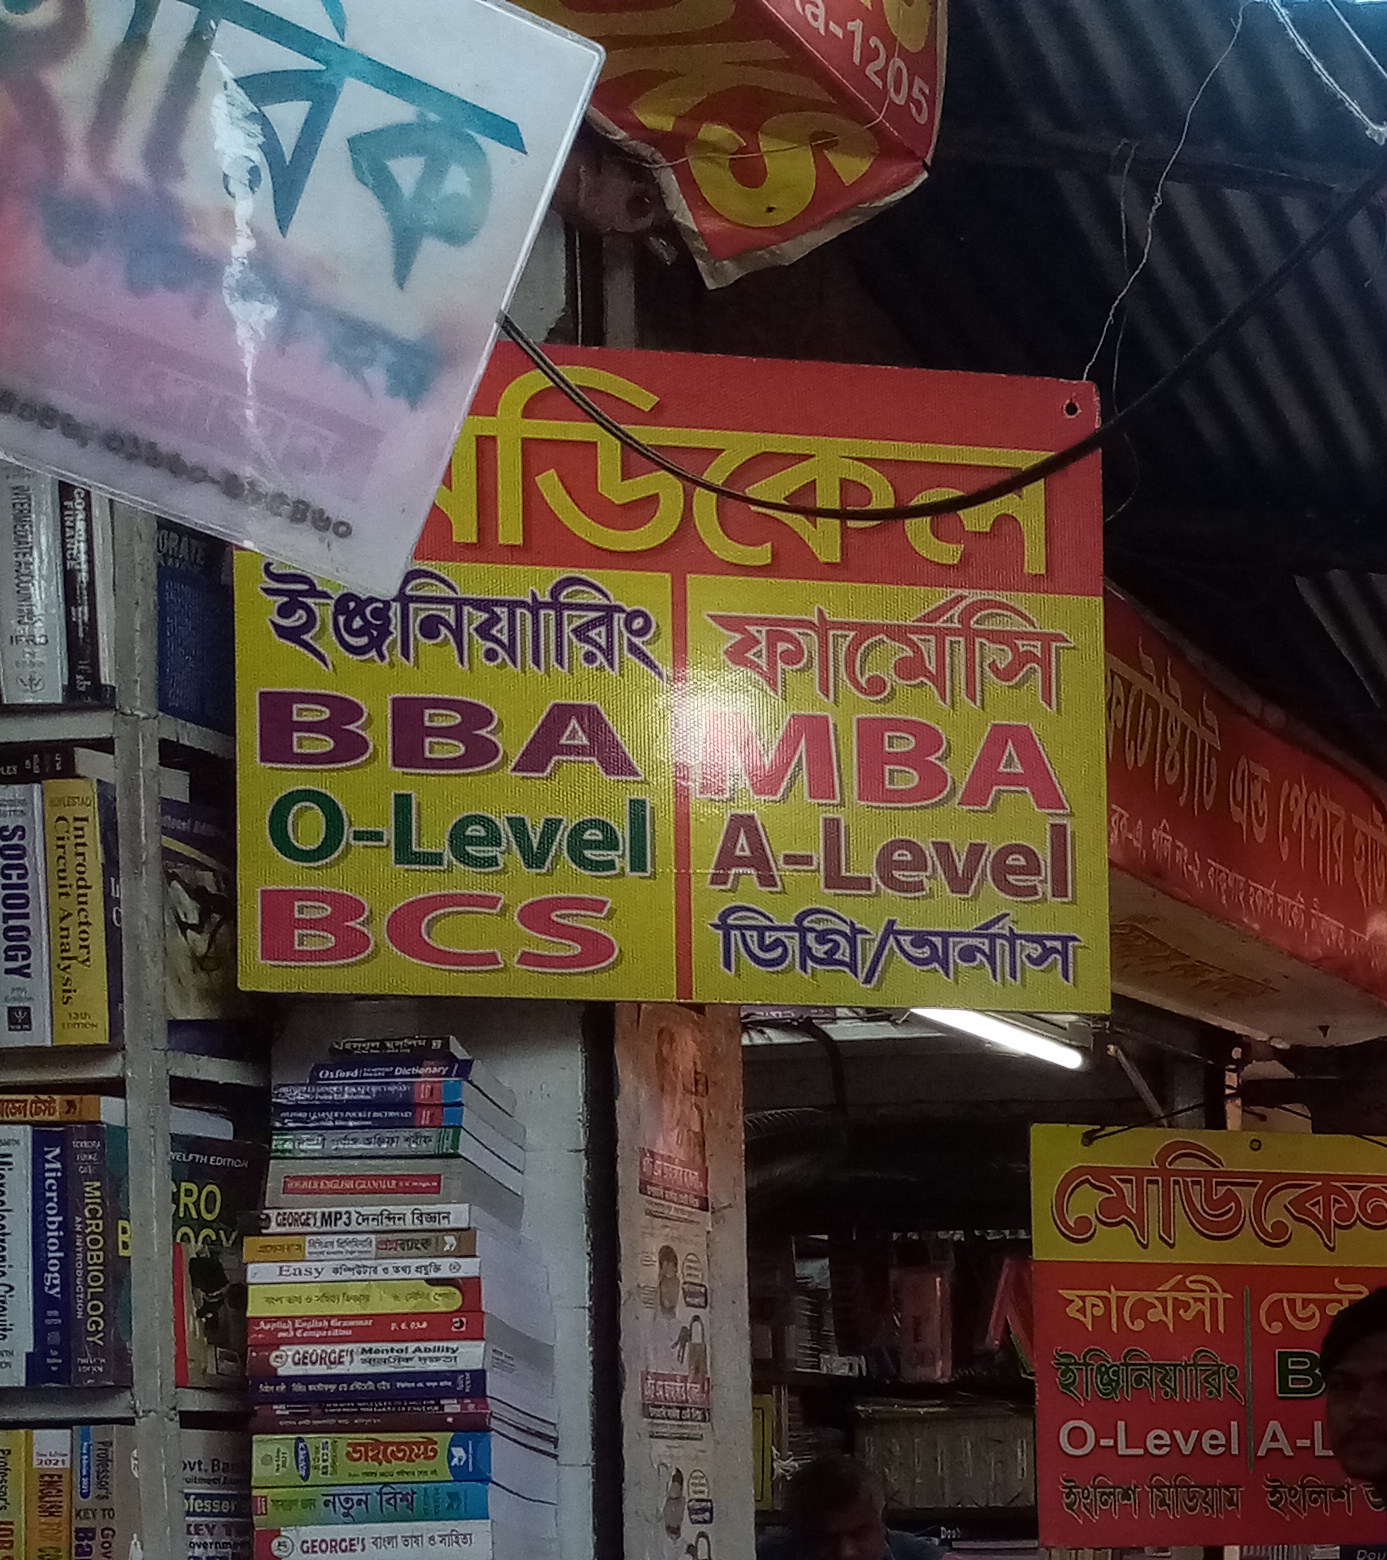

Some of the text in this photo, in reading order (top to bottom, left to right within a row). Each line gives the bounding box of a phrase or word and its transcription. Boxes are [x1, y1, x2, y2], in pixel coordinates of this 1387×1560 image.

[706, 597, 1077, 710] ফার্মেসি
[256, 690, 1072, 815] BBA MBA
[54, 816, 72, 897] Circuit
[267, 787, 1074, 903] O-Level A-Level
[0, 824, 32, 979] SOCIOLOGY
[71, 815, 93, 969] Introductory
[258, 888, 620, 973] BCS
[57, 907, 79, 1006] Analysis
[317, 1063, 449, 1080] Oxford Dictionary
[43, 1146, 65, 1301] Microbiology
[320, 1207, 451, 1228] MP3 বিজ্ঞান
[83, 1179, 106, 1348] MICROBIOLOGY
[1058, 1274, 1234, 1334] ফার্মেসী
[292, 1348, 356, 1368] GEORGE'S
[1059, 1420, 1239, 1456] O-Level
[100, 1507, 115, 1521] TO
[300, 1537, 366, 1555] GEORGE'S
[322, 1491, 370, 1519] নতুন
